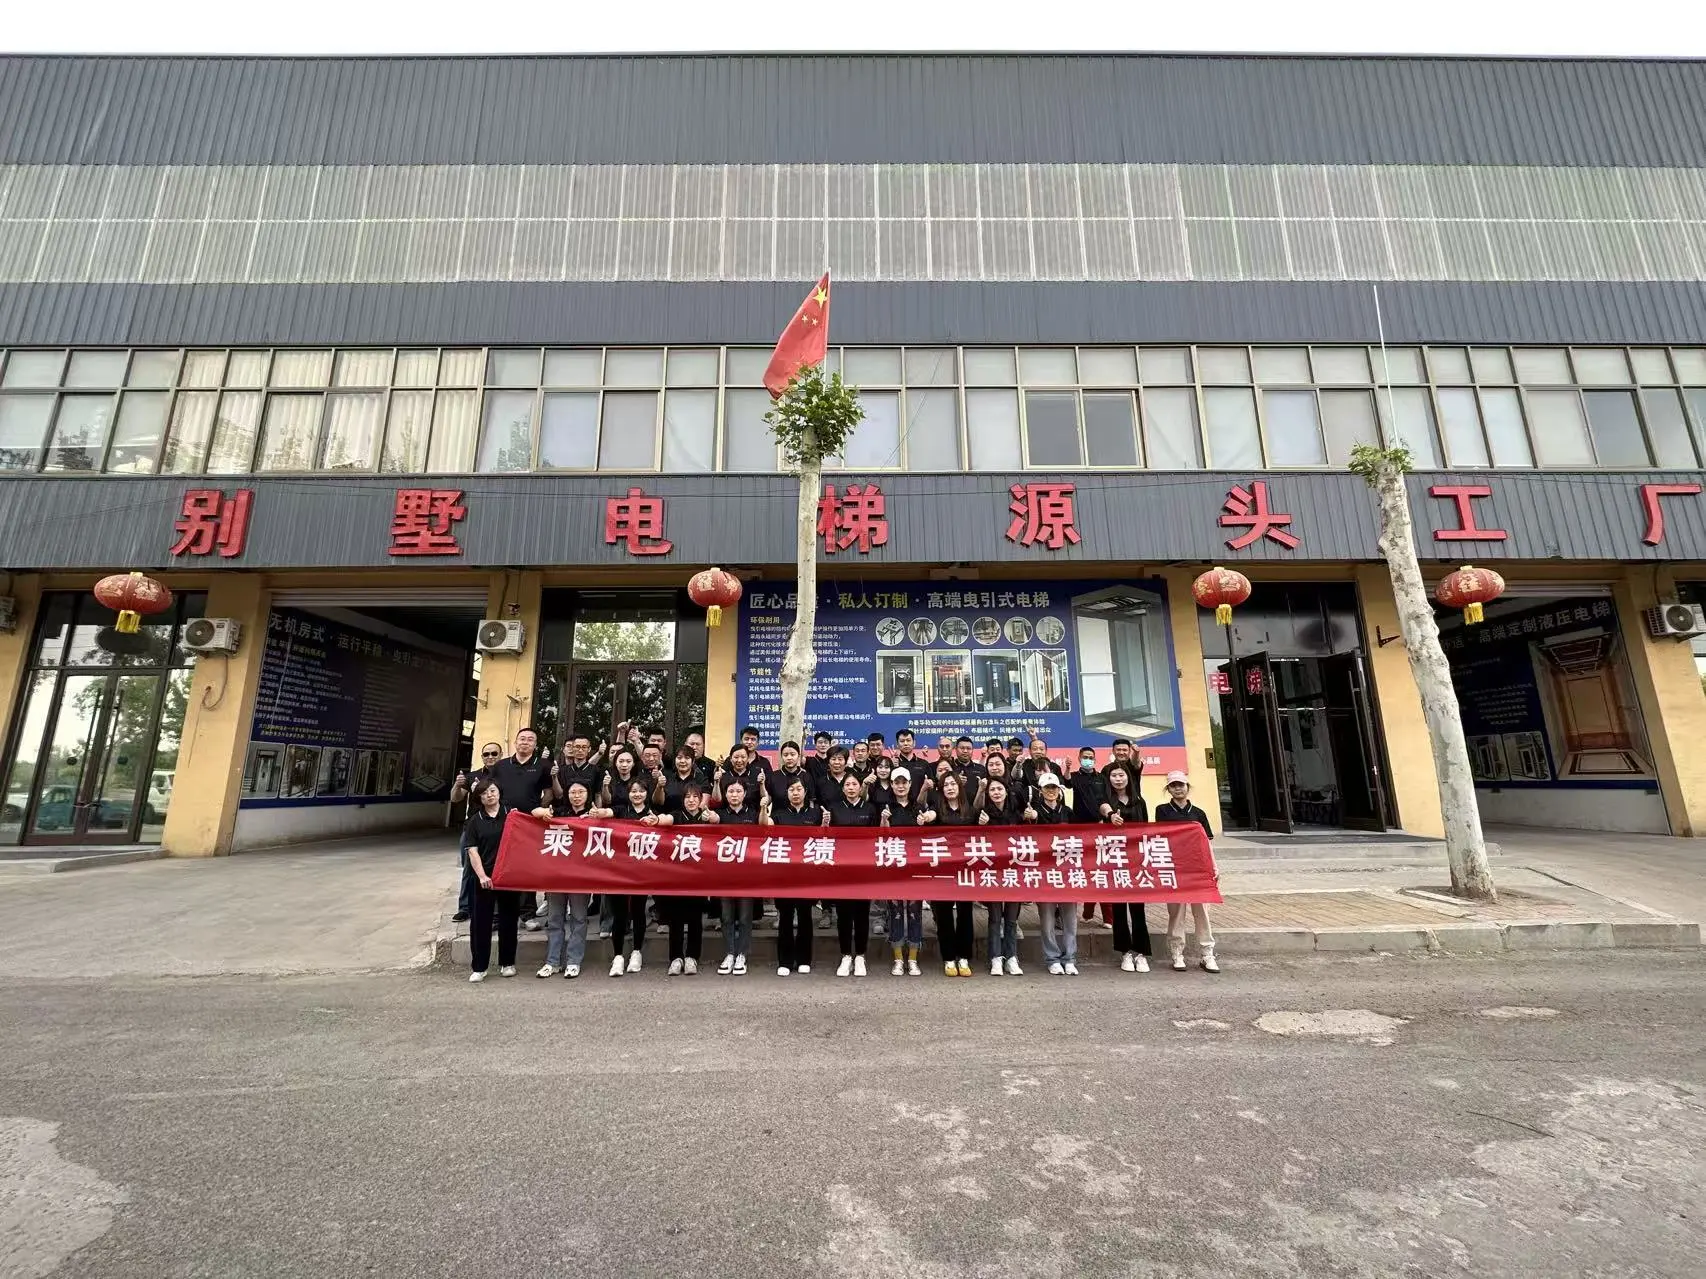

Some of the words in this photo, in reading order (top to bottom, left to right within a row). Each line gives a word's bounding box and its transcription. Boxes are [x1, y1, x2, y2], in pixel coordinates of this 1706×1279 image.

[169, 481, 1702, 559] 别墅电梯源头工厂
[750, 592, 818, 609] 匠心品
[838, 591, 909, 609] 私人订制
[926, 591, 1050, 609] 高端曳引式电梯
[1479, 600, 1611, 644] 高端定制液压电梯
[540, 824, 836, 866] 乘风破浪创佳绩
[874, 835, 1175, 868] 携手共进铸辉煌
